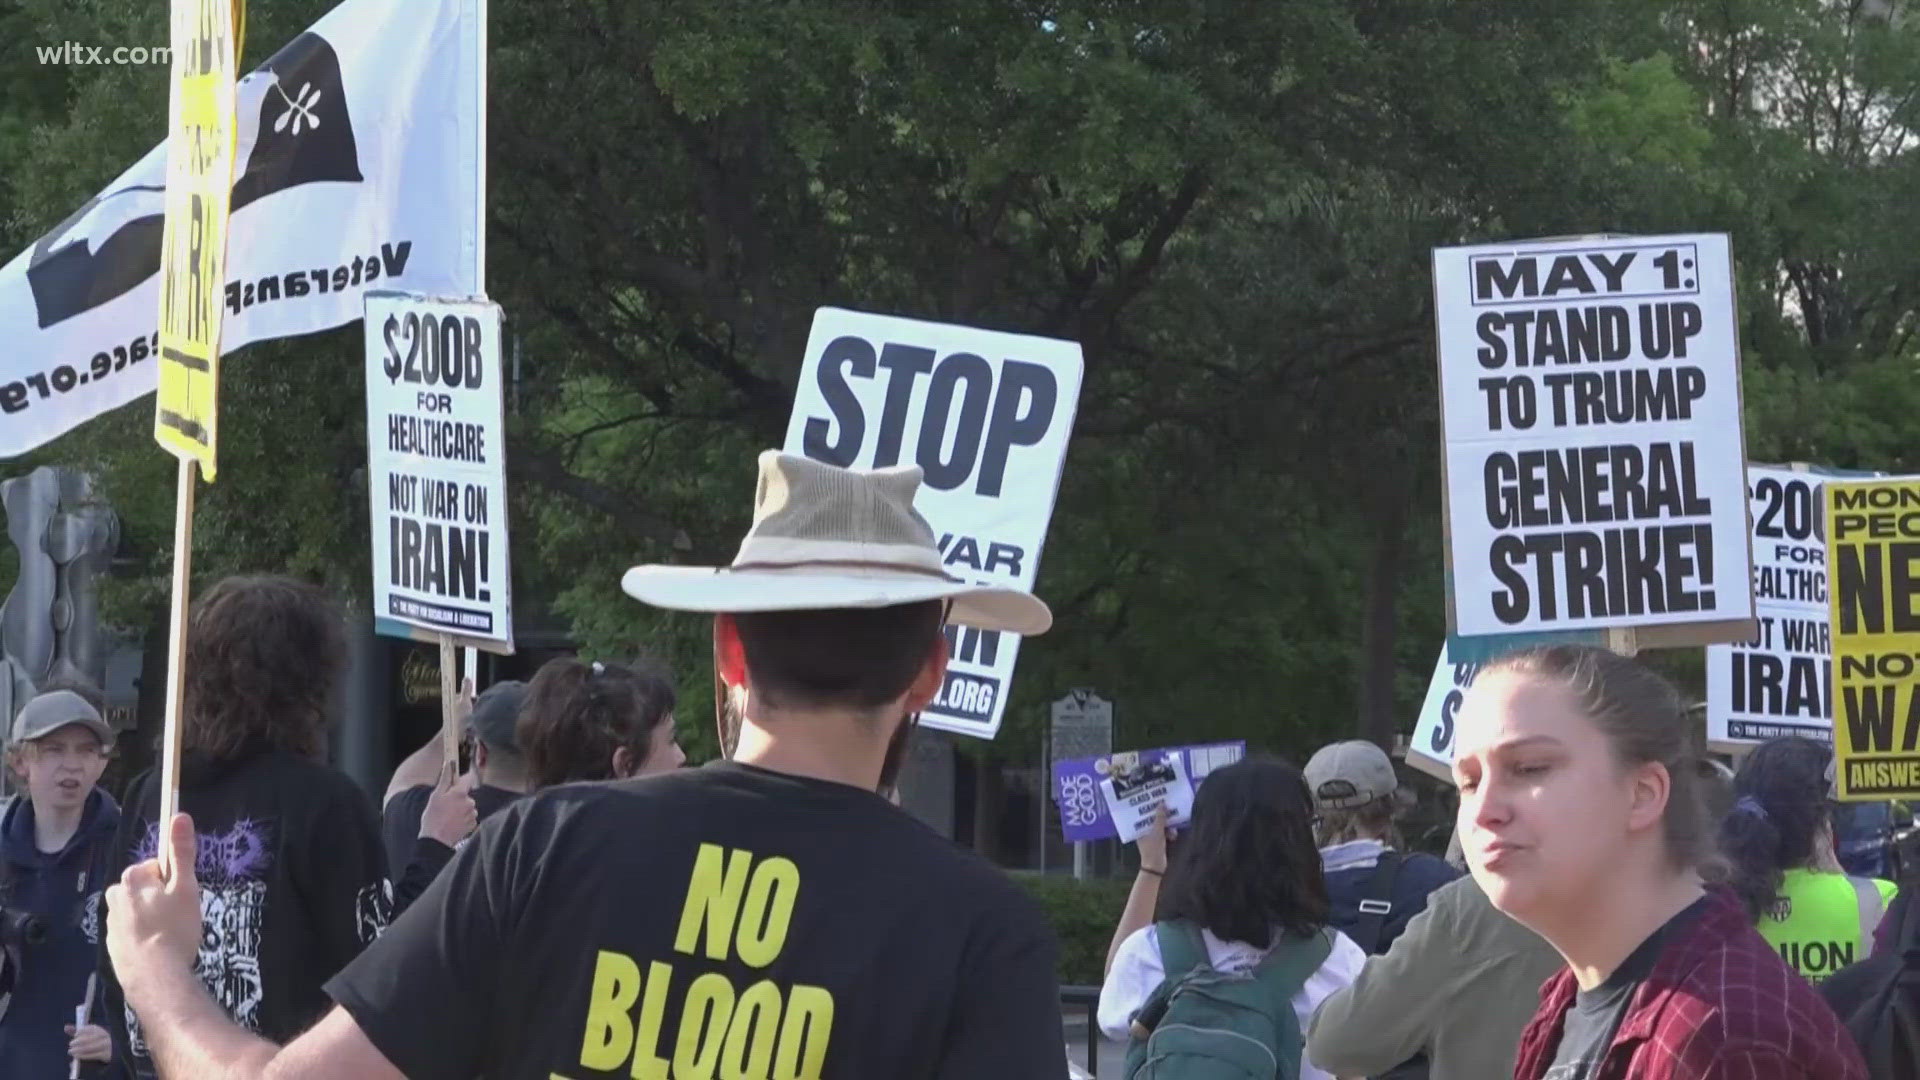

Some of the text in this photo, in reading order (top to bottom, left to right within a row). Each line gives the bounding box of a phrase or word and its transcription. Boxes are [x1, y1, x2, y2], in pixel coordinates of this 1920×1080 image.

[1475, 249, 1695, 299] MAY 1:
[383, 311, 483, 390] $200B
[1476, 302, 1702, 370] STAND UP
[417, 391, 452, 415] FOR
[803, 335, 1057, 499] STOP
[1478, 366, 1706, 431] TO TRUMP
[388, 413, 486, 464] HEALTHCARE
[389, 472, 488, 526] NOT WAR ON
[1484, 441, 1711, 530] GENERAL
[1833, 487, 1920, 511] MON
[389, 516, 491, 603] IRAN!
[1489, 522, 1716, 626] STRIKE!
[1775, 545, 1825, 565] FOR
[1836, 542, 1920, 636] NE
[1782, 617, 1831, 654] WAR
[1841, 652, 1920, 679] NO
[1061, 776, 1082, 826] MADE
[1077, 773, 1097, 826] GOOD
[1851, 761, 1920, 788] ANSWE
[674, 842, 800, 968] NO
[580, 950, 834, 1080] BLOOD
